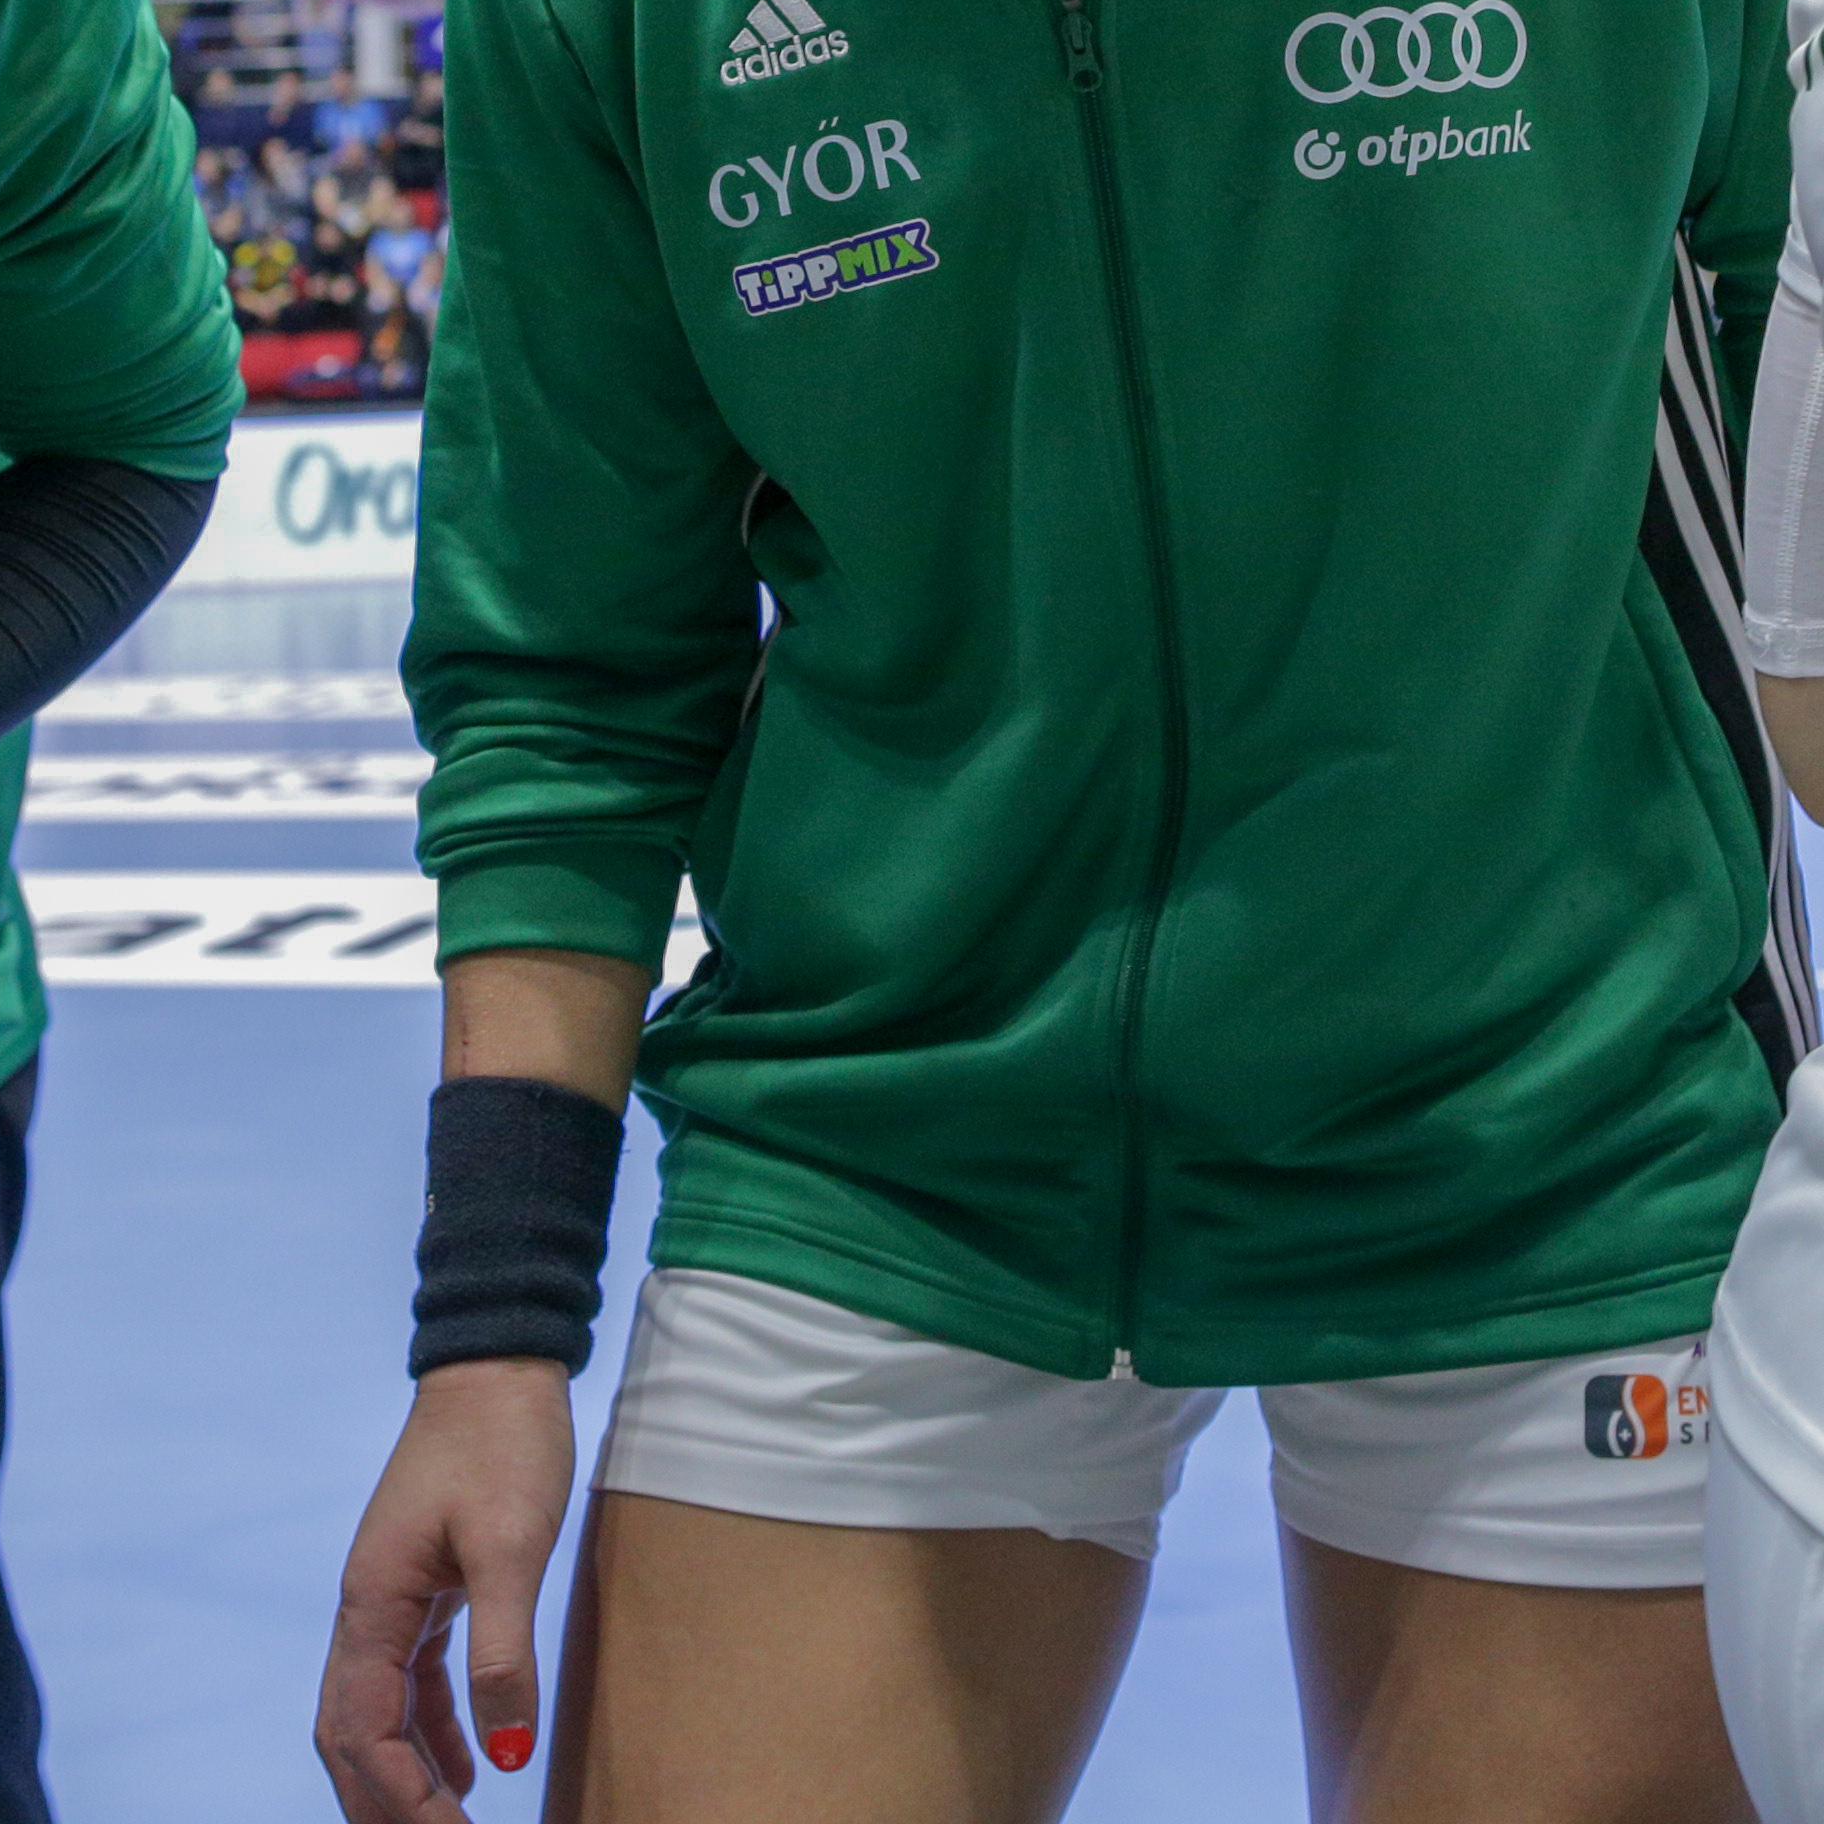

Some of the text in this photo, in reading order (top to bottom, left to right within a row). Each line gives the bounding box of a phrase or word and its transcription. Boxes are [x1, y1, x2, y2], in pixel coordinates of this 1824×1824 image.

[720, 29, 849, 86] adidas
[708, 116, 922, 229] GYŐR
[1357, 109, 1532, 176] otpbank
